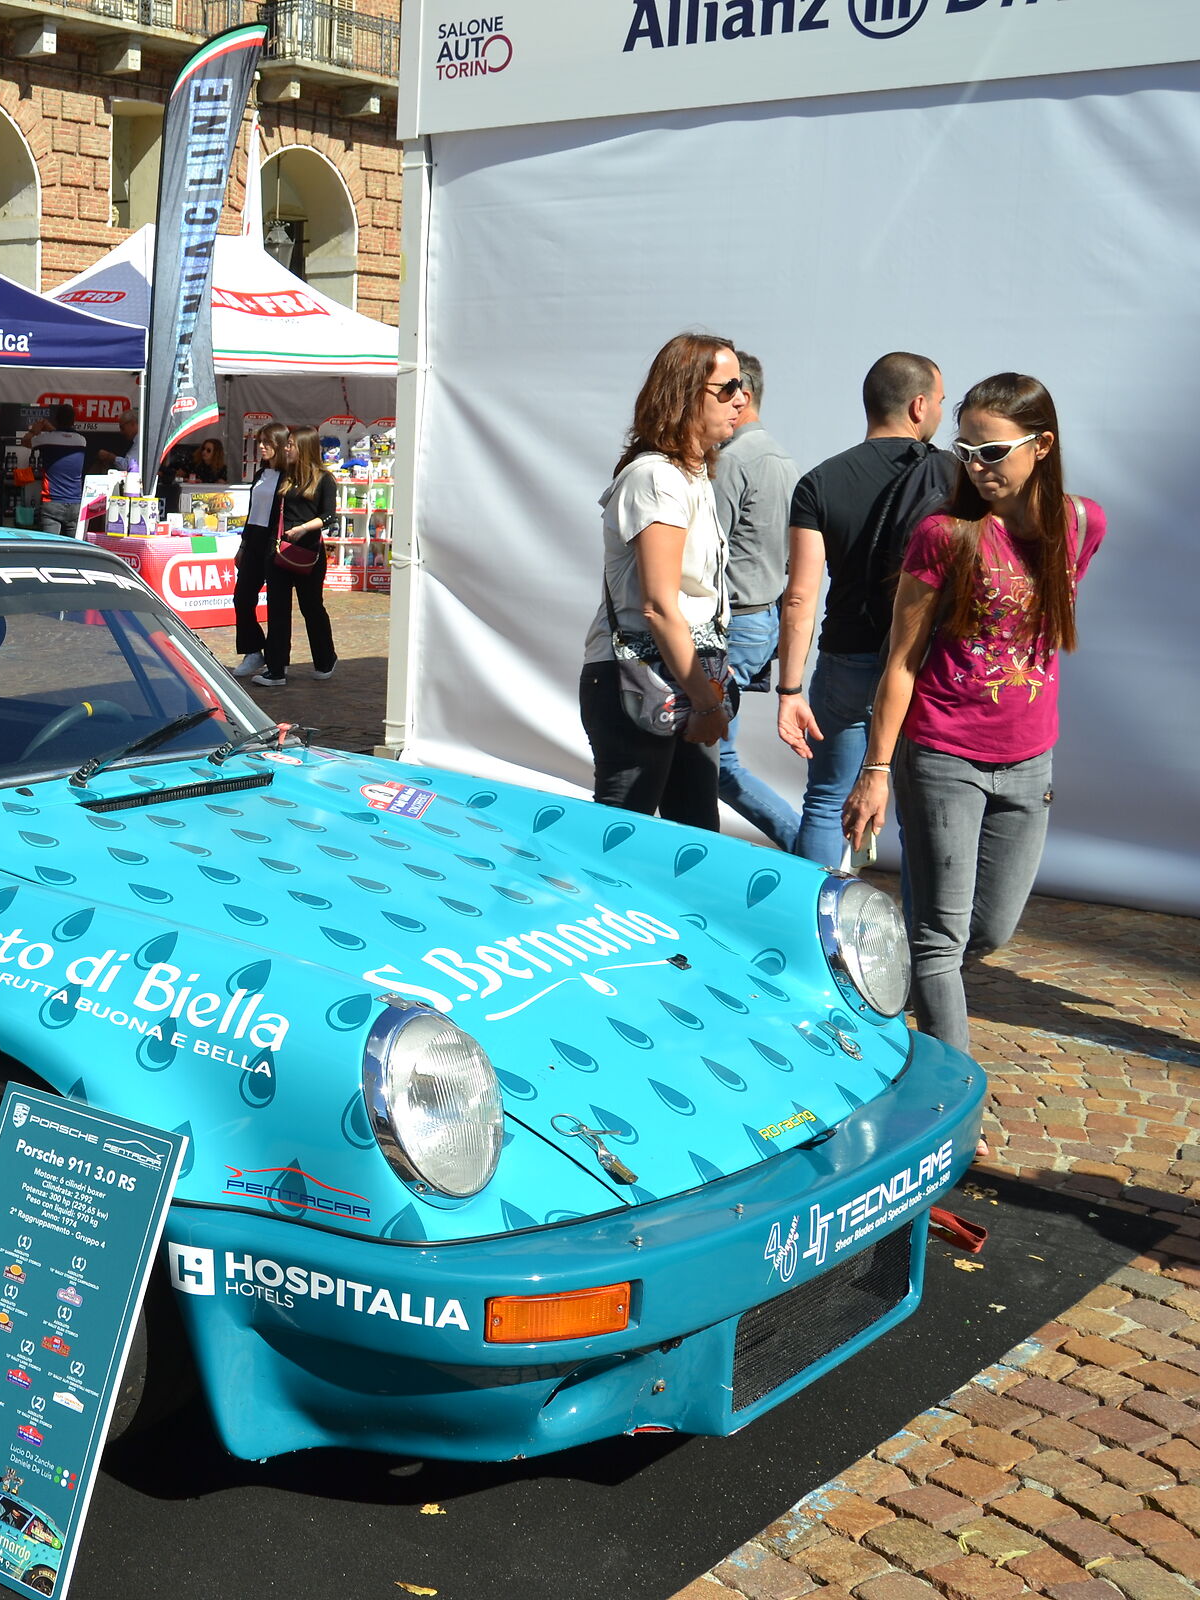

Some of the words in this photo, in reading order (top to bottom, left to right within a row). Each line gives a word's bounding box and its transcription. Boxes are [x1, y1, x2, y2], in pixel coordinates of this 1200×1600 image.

[438, 16, 503, 39] SALONE
[623, 0, 829, 52] Allianz
[189, 82, 231, 189] LINE
[65, 949, 131, 993] di
[133, 963, 290, 1053] Biella
[74, 998, 164, 1042] BUONA
[170, 1033, 189, 1049] E
[193, 1040, 273, 1079] BELLA
[29, 1114, 99, 1144] PORSCHE
[15, 1138, 66, 1167] Porsche
[66, 1156, 91, 1176] 911
[93, 1165, 116, 1185] 3.0
[117, 1173, 136, 1192] RS
[33, 1167, 58, 1182] Motore:
[58, 1176, 64, 1184] 6
[64, 1178, 86, 1192] cilindri
[86, 1186, 106, 1199] boxer
[21, 1182, 48, 1198] Potenza:
[48, 1192, 62, 1203] 300
[61, 1196, 71, 1207] hp
[41, 1179, 73, 1197] Cilindrata:
[74, 1191, 92, 1204] 2.992
[226, 1179, 371, 1218] PENTACAR
[836, 1138, 953, 1233] TECNOLAME
[25, 1193, 41, 1205] Peso
[41, 1201, 53, 1210] con
[53, 1204, 75, 1219] liquidi:
[75, 1212, 89, 1222] 970
[88, 1216, 98, 1228] kg
[40, 1209, 60, 1222] Anno:
[61, 1216, 77, 1228] 1974
[854, 1220, 875, 1241] Blades
[875, 1212, 887, 1227] and
[888, 1198, 909, 1221] Special
[16, 1210, 70, 1237] Raggruppamento
[74, 1231, 100, 1248] Gruppo
[100, 1240, 105, 1248] 4
[224, 1251, 470, 1331] HOSPITALIA
[224, 1280, 295, 1309] HOTELS
[9, 1442, 25, 1456] Lucio
[24, 1449, 34, 1460] Da
[33, 1454, 55, 1470] Zanche
[9, 1453, 31, 1470] Daniele
[31, 1463, 41, 1474] De
